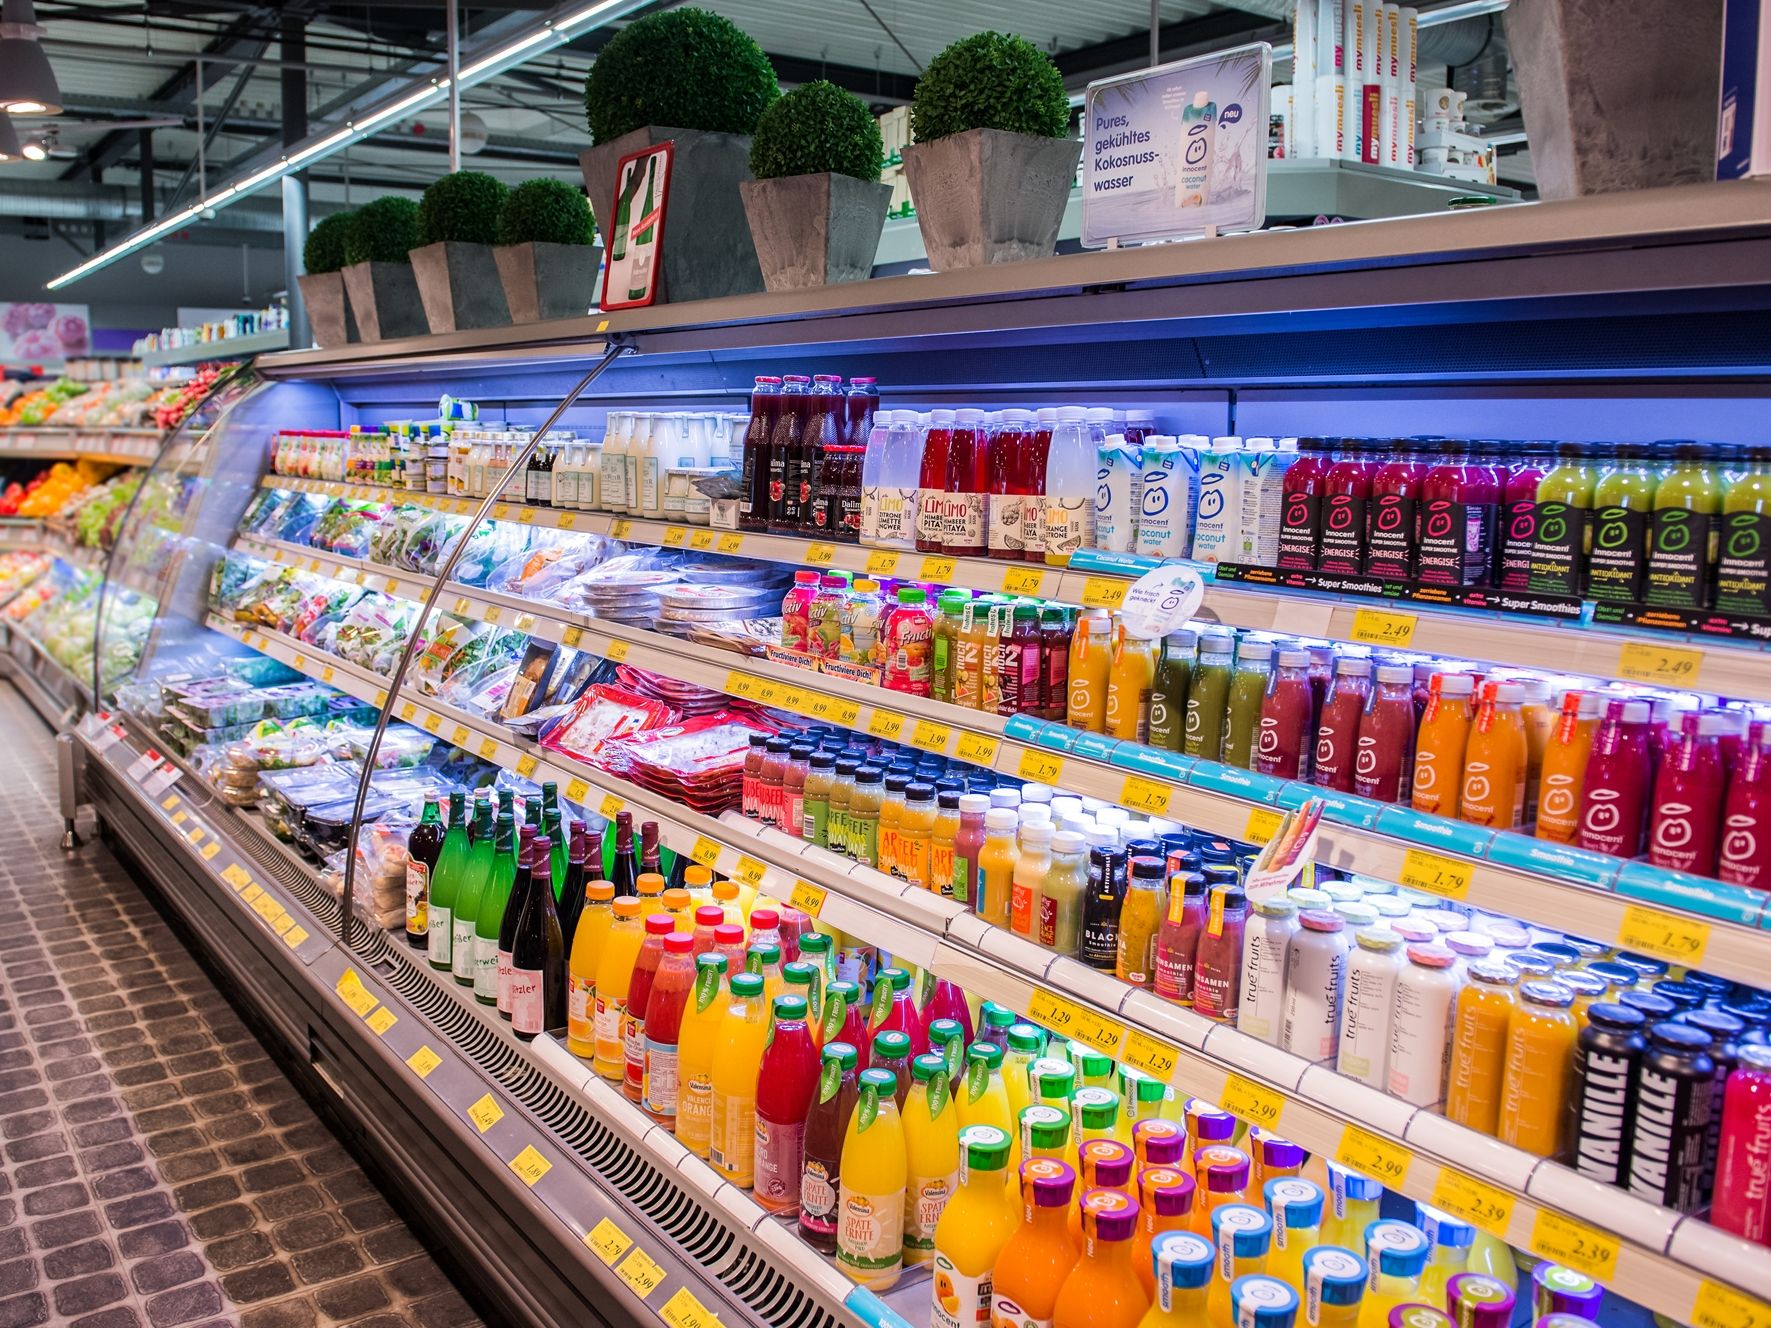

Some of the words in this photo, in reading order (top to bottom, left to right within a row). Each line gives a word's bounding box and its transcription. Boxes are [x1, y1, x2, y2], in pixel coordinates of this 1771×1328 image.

[1388, 11, 1399, 77] mymuesli
[1096, 115, 1130, 131] Pures,
[1224, 109, 1239, 119] neu
[1335, 85, 1344, 152] mymuesli
[1369, 93, 1379, 160] mymuesli
[1095, 130, 1150, 155] gekühltes
[1094, 151, 1160, 172] Kokosnuss-
[1094, 174, 1134, 192] wasser
[1181, 175, 1207, 184] coconut
[1283, 526, 1310, 535] innocent
[1326, 529, 1355, 538] innocent
[1374, 531, 1404, 540] innocent
[1143, 538, 1162, 546] water
[1198, 542, 1216, 550] water
[1281, 543, 1310, 554] ENERGISE
[1336, 538, 1358, 546] SMOOTHIE
[1424, 537, 1455, 546] innocent
[1534, 543, 1569, 552] innocent
[1324, 547, 1355, 558] ENERGISE
[1372, 548, 1403, 560] ENERGISE
[1422, 556, 1454, 567] ENERGISE
[1593, 549, 1632, 558] innocent
[1654, 552, 1694, 561] innocent
[881, 559, 895, 568] 1.79
[935, 565, 952, 575] 1.79
[1721, 558, 1765, 568] innocent
[1021, 578, 1039, 588] 1.79
[1318, 578, 1340, 590] Super
[1342, 581, 1383, 594] Smoothies
[1102, 589, 1122, 600] 2.49
[1144, 589, 1160, 597] frisch
[1463, 598, 1487, 606] Vitamine
[1502, 597, 1529, 610] Super
[1531, 600, 1580, 615] Smoothies
[963, 611, 971, 630] hohes
[989, 614, 997, 634] hohes
[1383, 623, 1410, 638] 2.49
[770, 649, 798, 663] Fructiviere
[799, 655, 812, 667] Dich!
[956, 641, 966, 669] noch
[983, 645, 993, 674] noch
[824, 661, 855, 676] Fructiviere
[856, 667, 872, 680] Dich!
[1656, 659, 1693, 675] 2.49
[884, 721, 900, 732] 1.99
[929, 733, 946, 745] 1.99
[975, 745, 993, 758] 1.99
[1138, 752, 1166, 764] Smoothie
[1038, 763, 1057, 777] 1.79
[1219, 773, 1251, 787] Smoothie
[1144, 793, 1167, 808] 1.79
[1414, 820, 1453, 836] Smoothie
[1582, 828, 1624, 844] innocent
[1653, 844, 1697, 861] innocent
[1720, 859, 1760, 875] innocent
[1433, 871, 1464, 889] 1.79
[1664, 881, 1715, 899] Smoothie
[1661, 931, 1700, 951] 1.79
[1249, 935, 1261, 969] fruits
[1328, 954, 1340, 989] fruits
[1246, 971, 1257, 1003] true
[1349, 968, 1361, 1006] fruits
[832, 997, 840, 1019] FRUCHT
[1049, 1006, 1071, 1025] 1.29
[1325, 990, 1336, 1025] true
[1345, 1007, 1357, 1040] true
[1460, 1005, 1476, 1049] fruits
[1095, 1028, 1118, 1047] 1.29
[1509, 1027, 1526, 1073] fruits
[1147, 1052, 1172, 1072] 1.29
[1455, 1048, 1471, 1089] true
[1505, 1072, 1521, 1113] true
[1248, 1099, 1277, 1119] 2.99
[1577, 1051, 1629, 1184] VANILLE
[1629, 1067, 1677, 1206] VANILLE
[1755, 1104, 1771, 1156] fruits
[1371, 1153, 1403, 1178] 2.99
[1744, 1155, 1767, 1200] true
[1334, 1183, 1344, 1218] smooth
[1470, 1197, 1506, 1223] 2.39
[845, 1226, 874, 1242] ERNTE
[1277, 1213, 1286, 1248] smooth
[604, 1239, 622, 1255] 2.79
[1572, 1239, 1610, 1264] 2.39
[1222, 1243, 1231, 1279] smooth
[634, 1272, 653, 1289] 2.99
[1369, 1257, 1378, 1293] smooth
[1162, 1272, 1172, 1310] smooth
[1308, 1285, 1318, 1323] smooth
